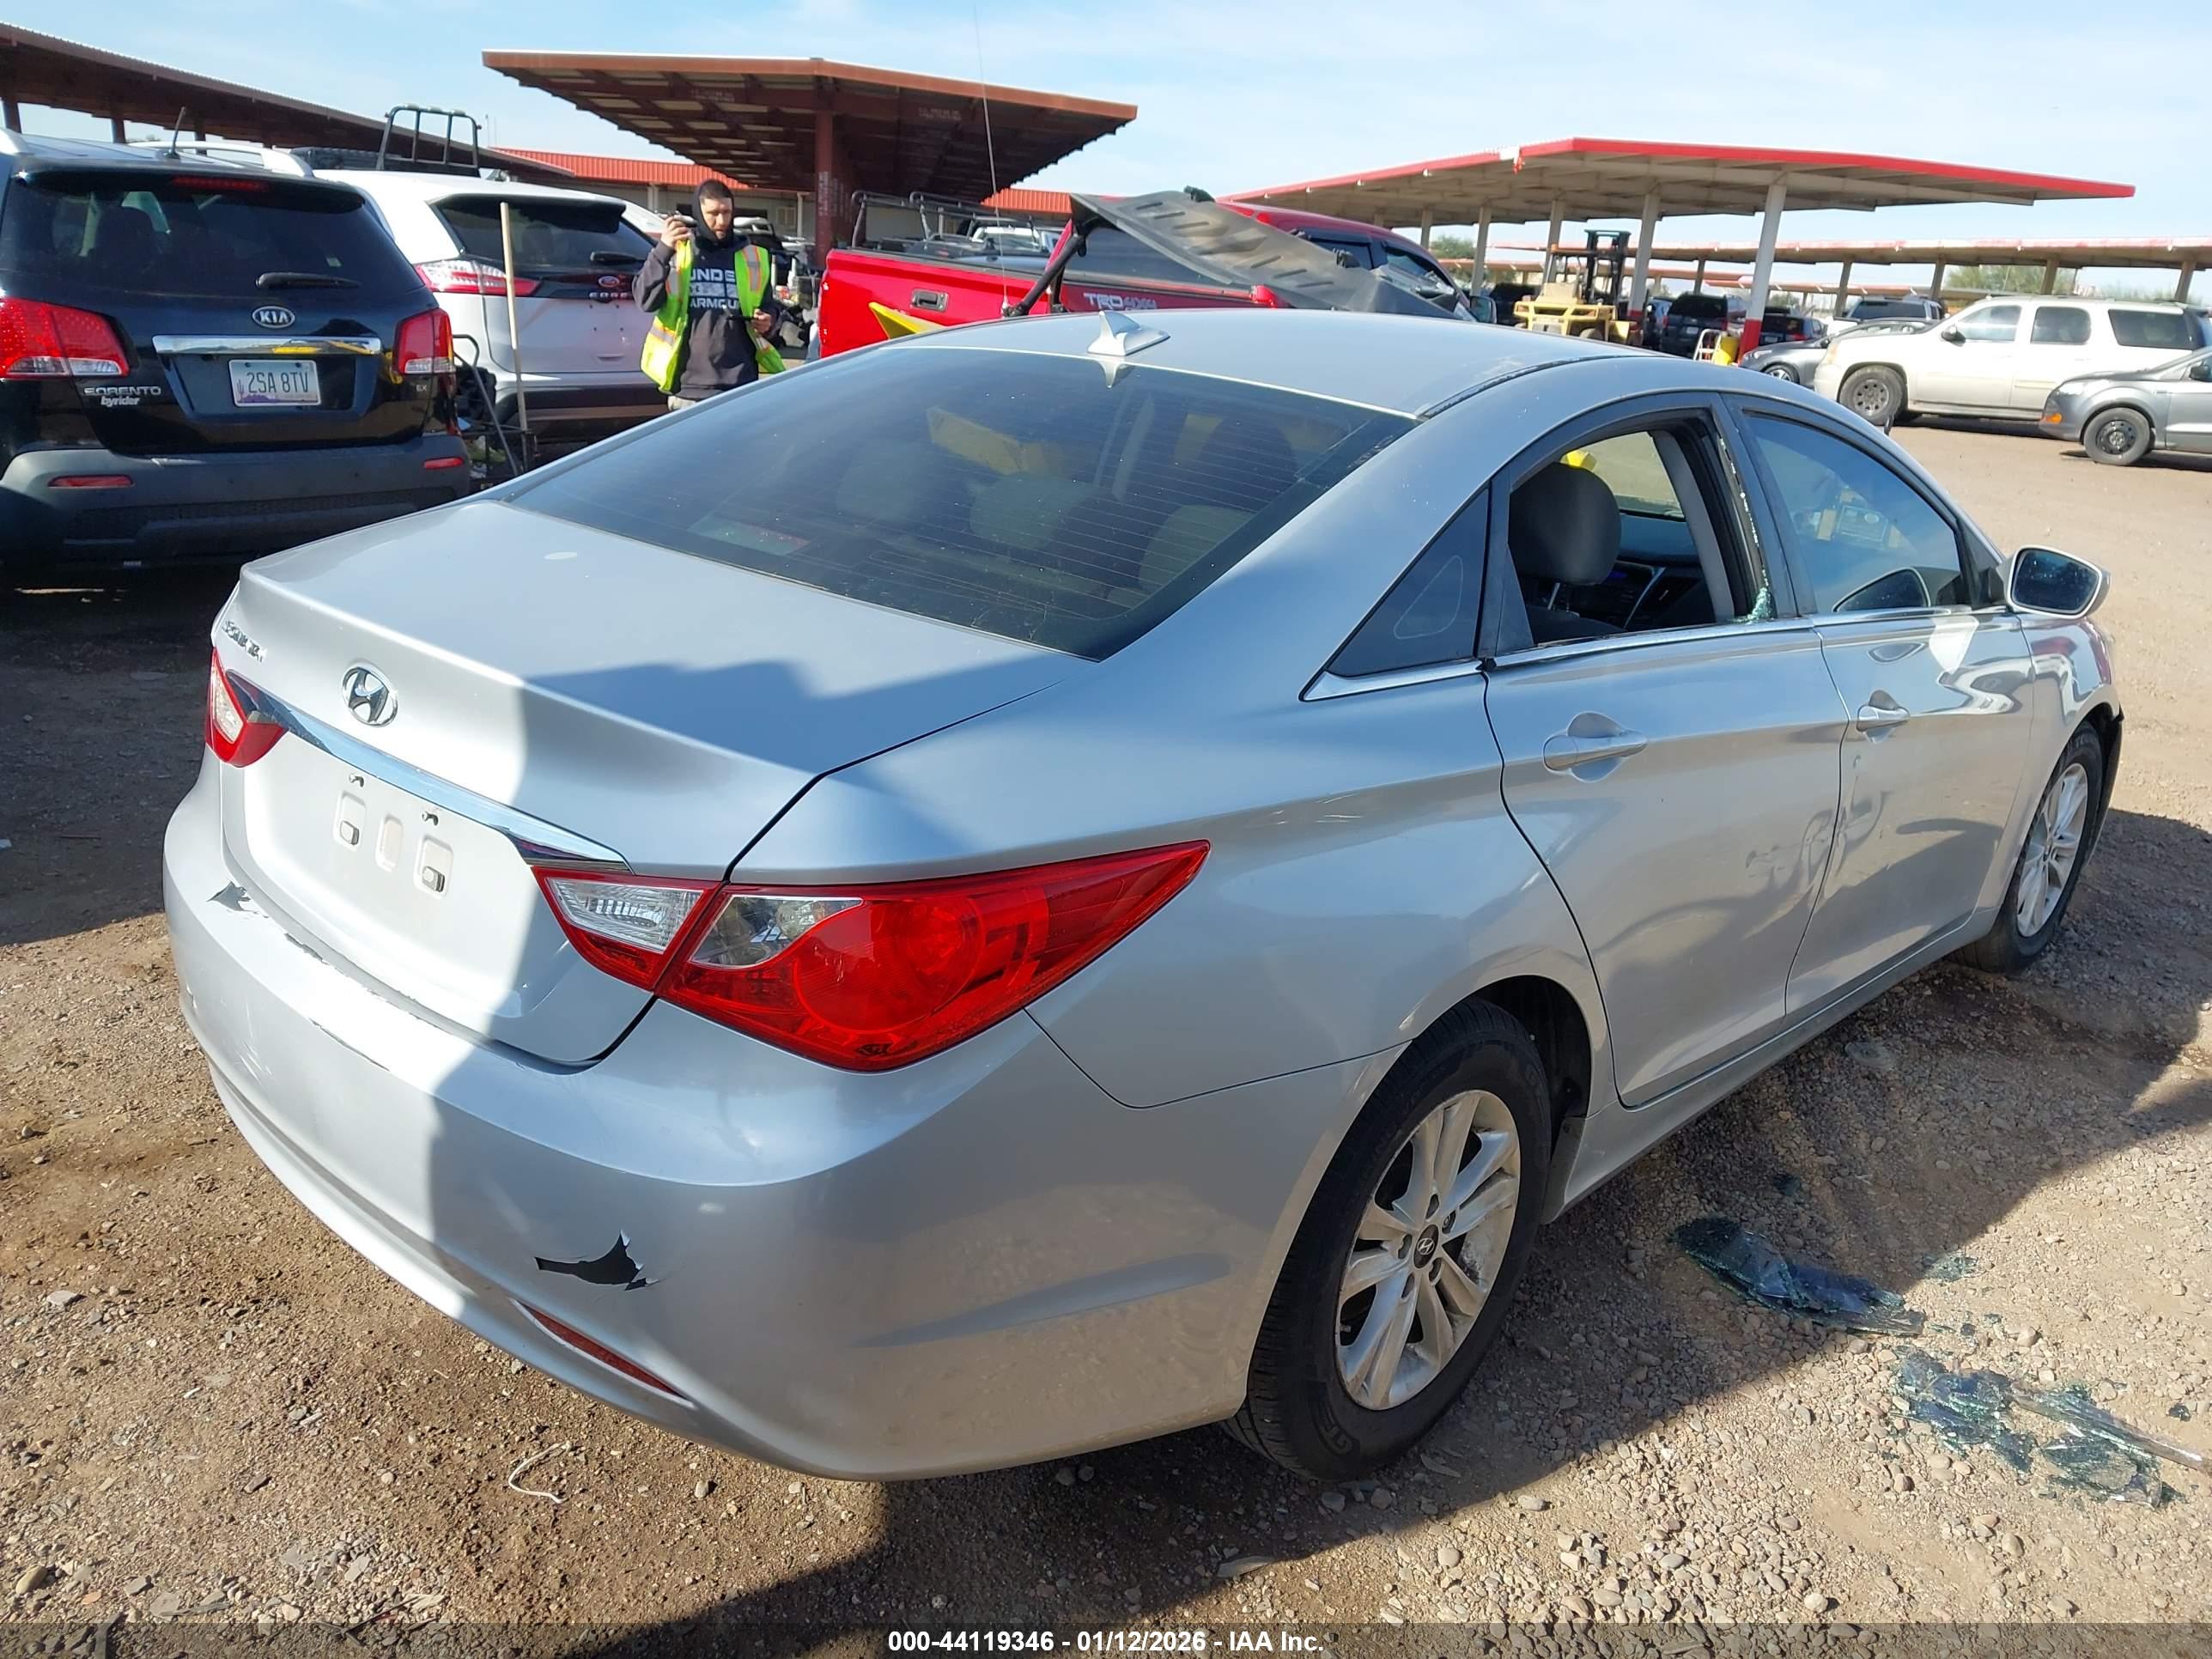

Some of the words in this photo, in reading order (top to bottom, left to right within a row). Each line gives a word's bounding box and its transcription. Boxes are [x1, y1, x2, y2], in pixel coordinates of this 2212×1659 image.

[690, 268, 736, 283] UNDE
[690, 297, 738, 309] ARMOU
[1083, 292, 1123, 310] TRD
[258, 310, 289, 323] KIA
[246, 372, 276, 393] 2SA
[280, 372, 309, 393] 8TV
[84, 386, 161, 396] SORENTO
[100, 396, 140, 407] byrider
